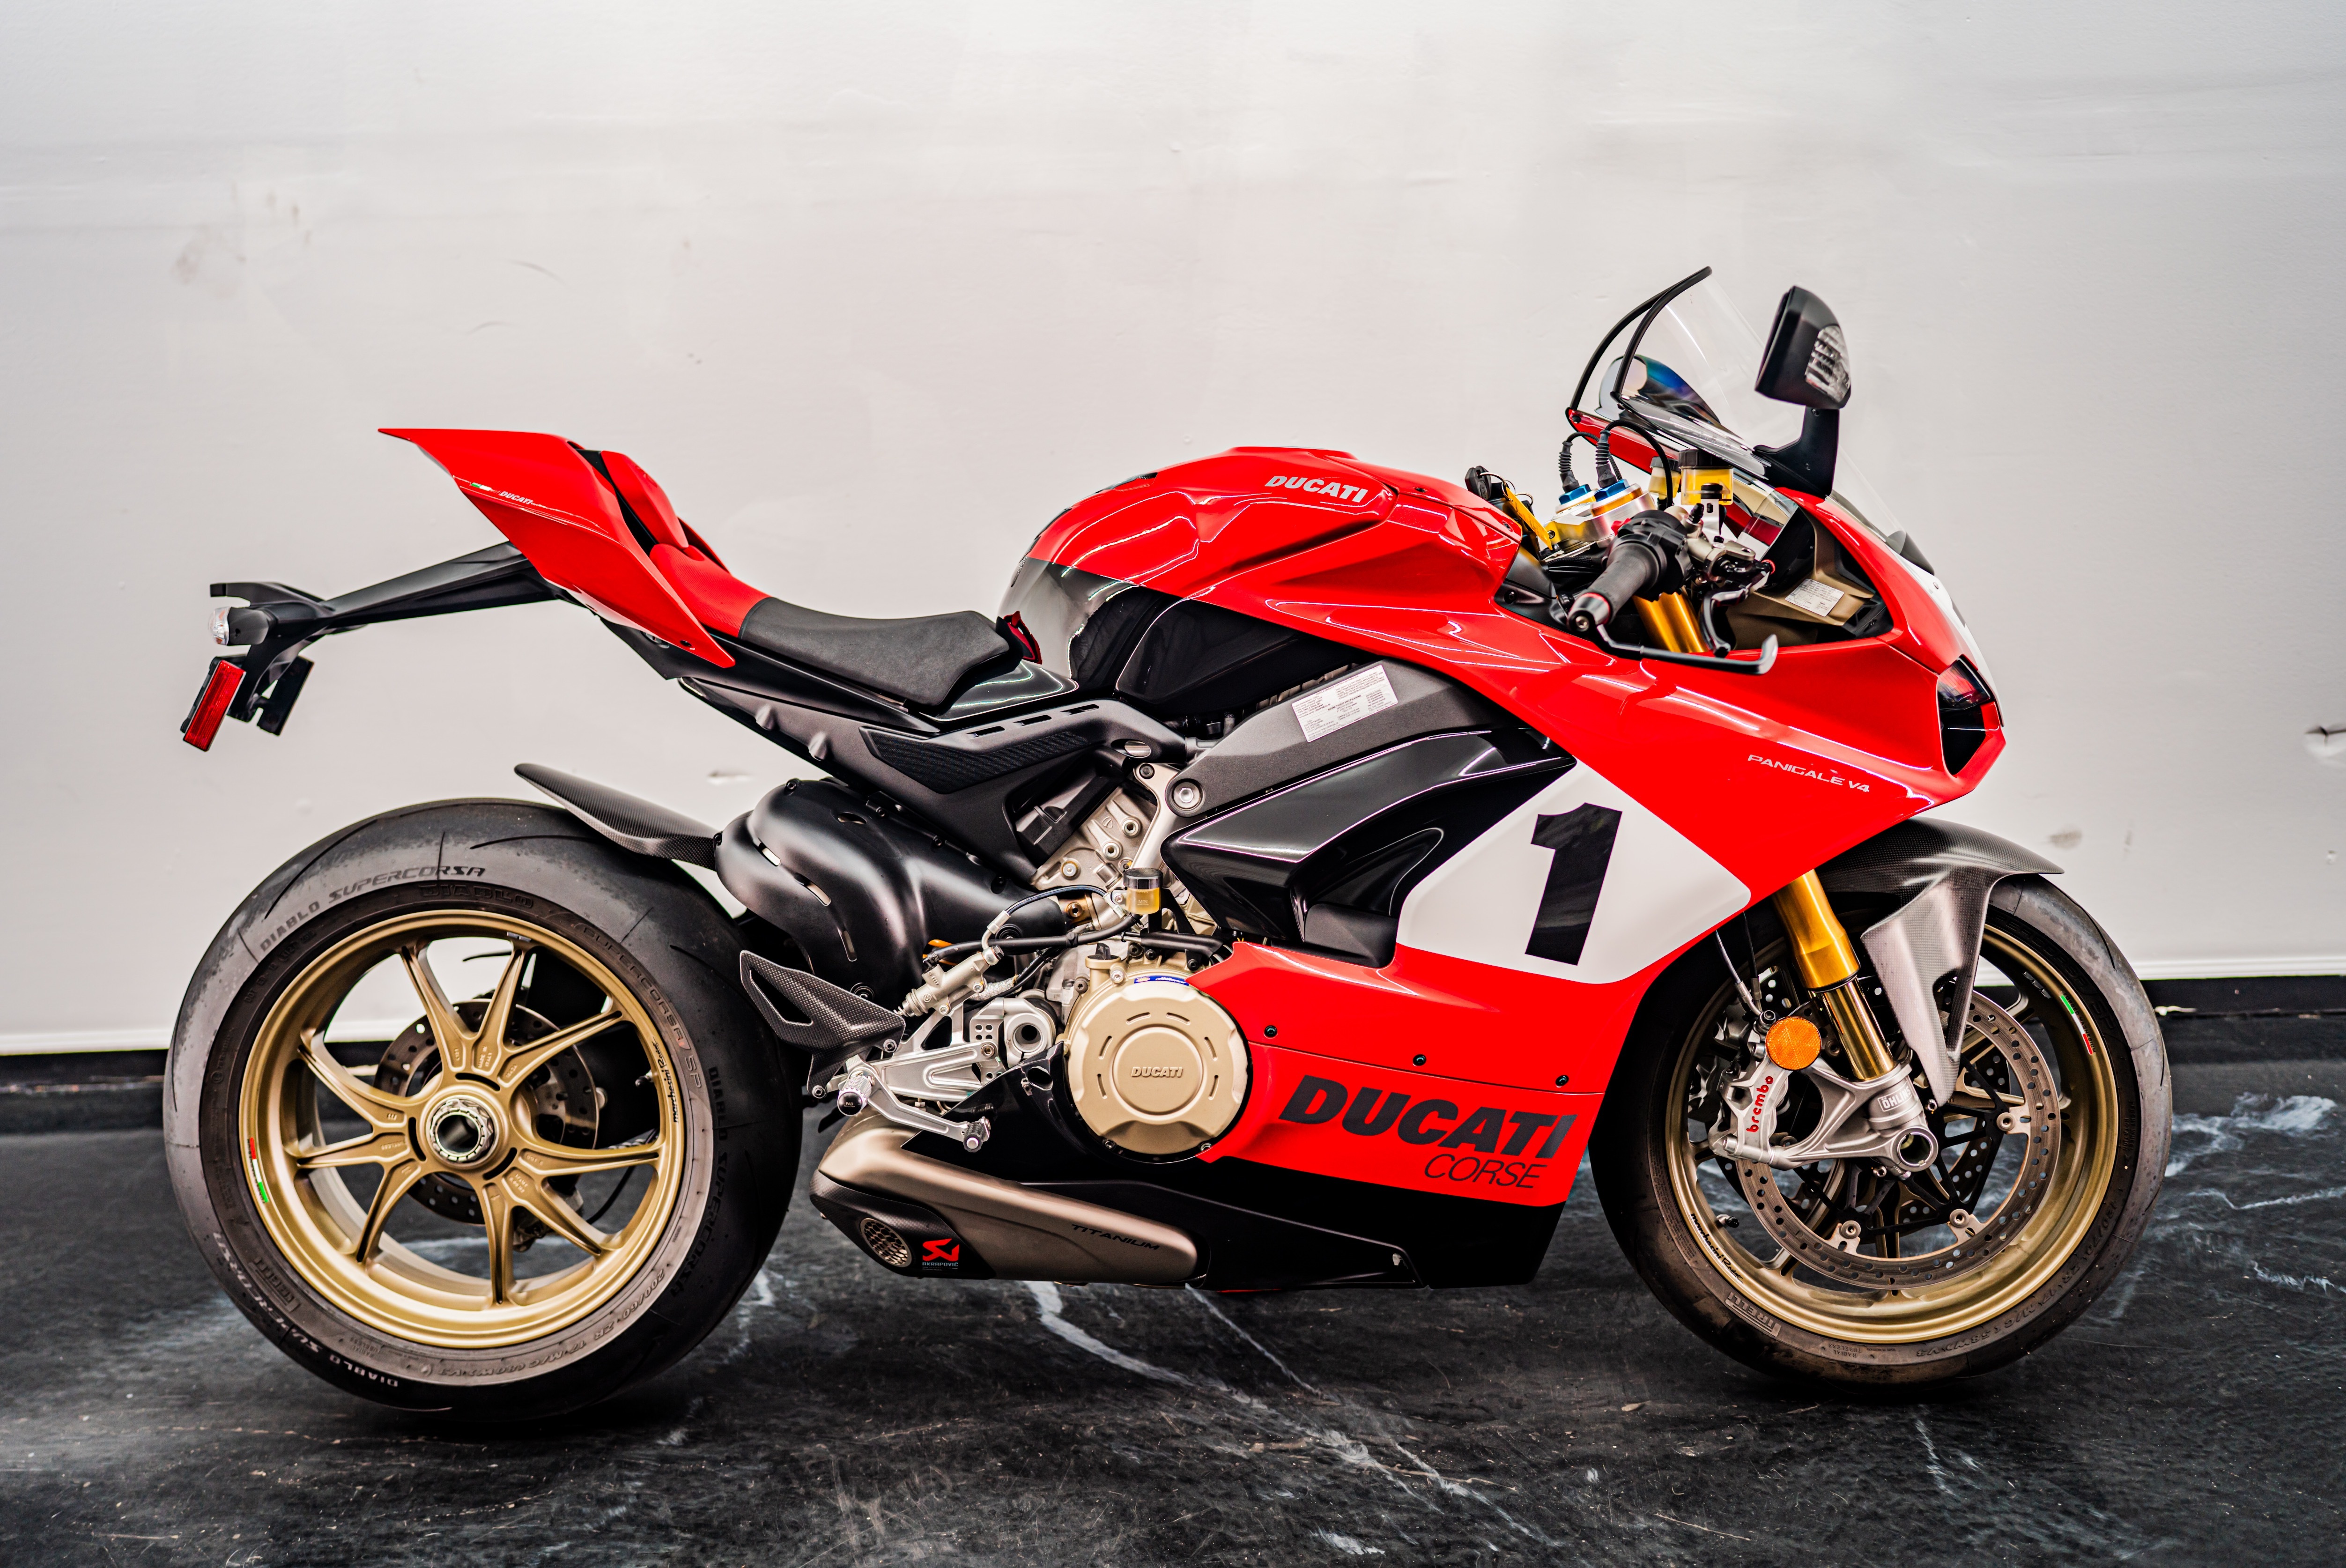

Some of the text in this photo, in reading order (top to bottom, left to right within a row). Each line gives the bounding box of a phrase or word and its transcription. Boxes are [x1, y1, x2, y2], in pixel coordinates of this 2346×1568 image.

[498, 491, 533, 504] DUCATI
[1265, 476, 1369, 503] DUCATI
[1747, 754, 1870, 792] PANIGALE V4
[419, 882, 536, 908] DIABLO
[1525, 802, 1622, 966] 1
[259, 865, 486, 953] DIABLO SUPERCORSA
[582, 926, 701, 1089] SUPERCORSA SP
[2064, 993, 2096, 1053] FORGED MAGNESIUM
[1130, 1066, 1183, 1078] DUCATI
[661, 1068, 679, 1123] marchesini
[1279, 1074, 1578, 1159] DUCATI
[1746, 1076, 1774, 1132] brembo
[1881, 1086, 1912, 1109] ÖHLINS
[670, 1065, 727, 1298] DIABLO SUPERCORSA
[1424, 1154, 1547, 1188] CORSE
[1071, 1224, 1160, 1250] TITANIUM
[1690, 1213, 1724, 1260] marchesini
[212, 1232, 399, 1387] DIABLO SUPERCORSA
[622, 1270, 664, 1320] 200/60
[1724, 1292, 1782, 1338] PIRELLI
[593, 1319, 618, 1341] ZR
[1828, 1342, 1861, 1354] TUBELESS
[1832, 1349, 1857, 1358] RADIAL
